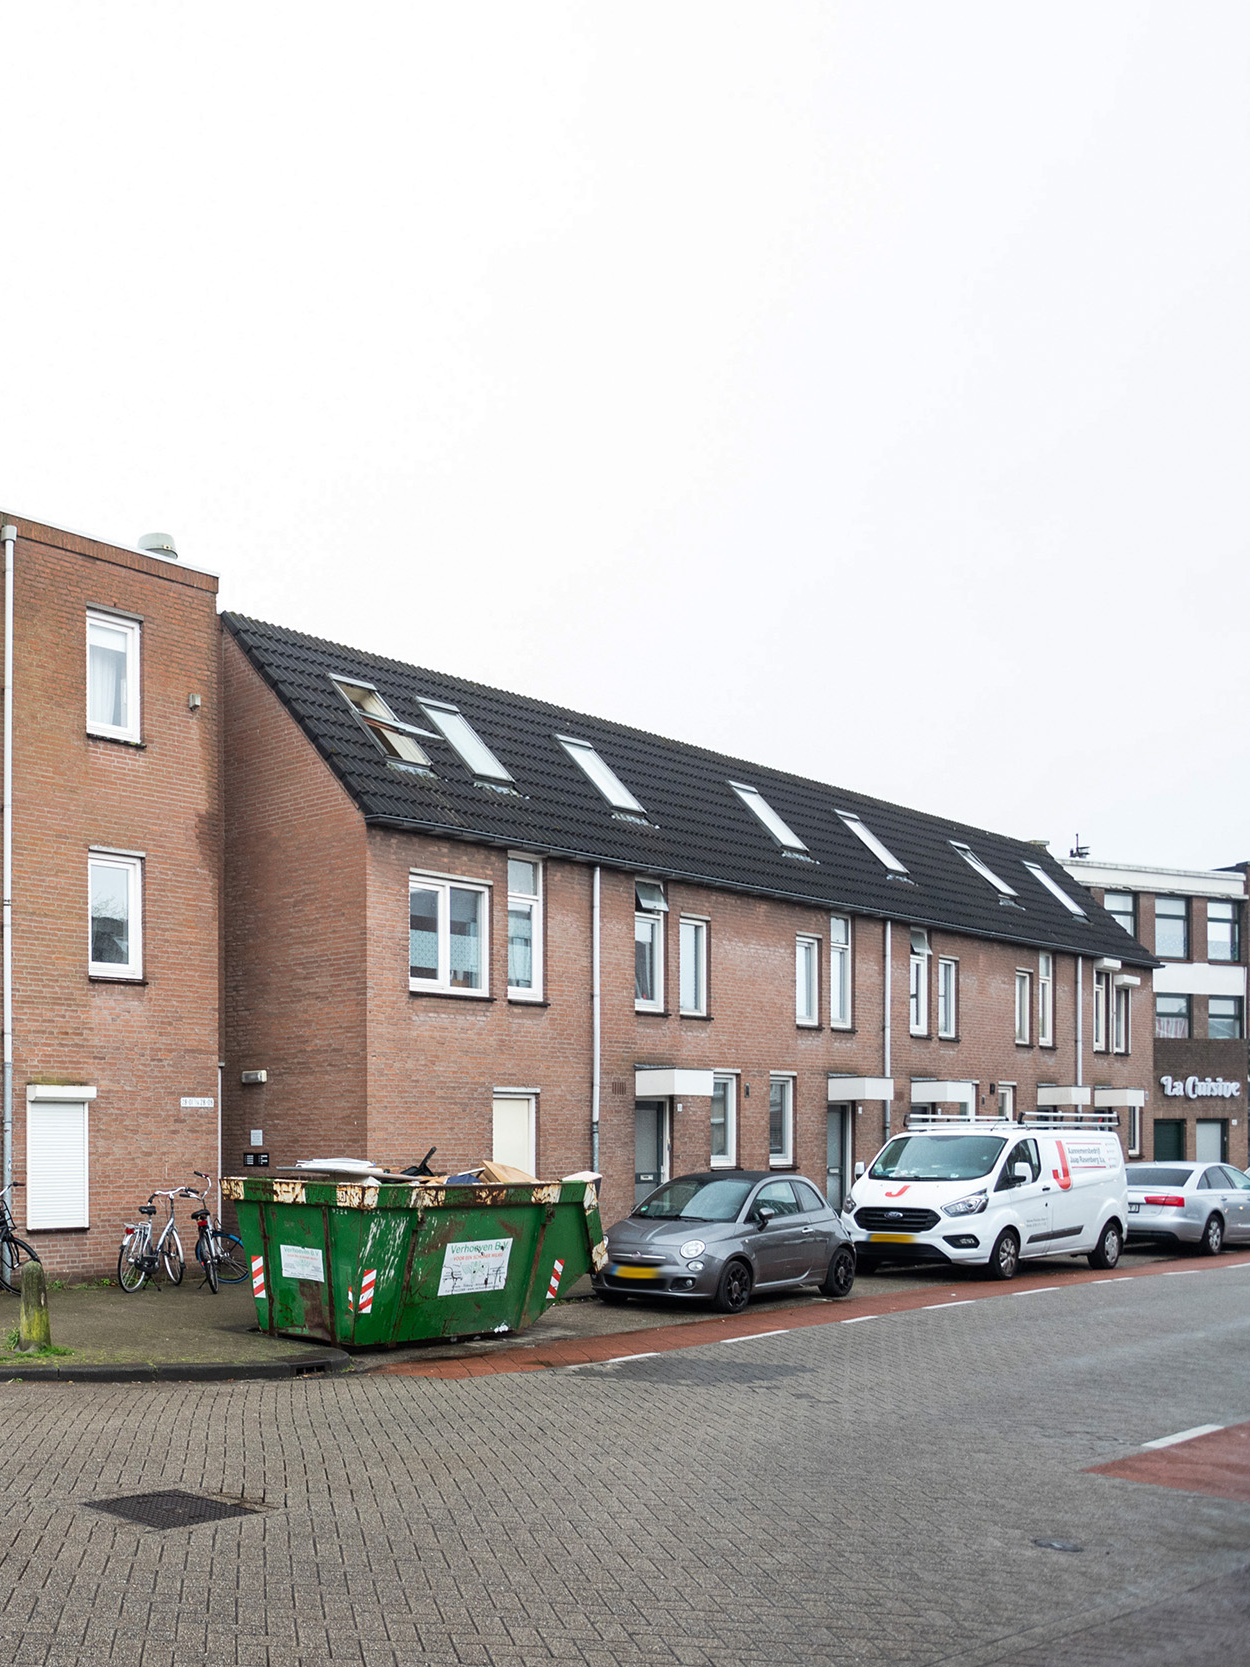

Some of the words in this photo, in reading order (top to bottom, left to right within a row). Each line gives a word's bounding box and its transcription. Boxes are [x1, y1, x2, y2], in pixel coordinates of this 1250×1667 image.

[1160, 1075, 1185, 1096] La
[1185, 1075, 1241, 1099] Cuisine
[451, 1243, 493, 1254] Verhoeven
